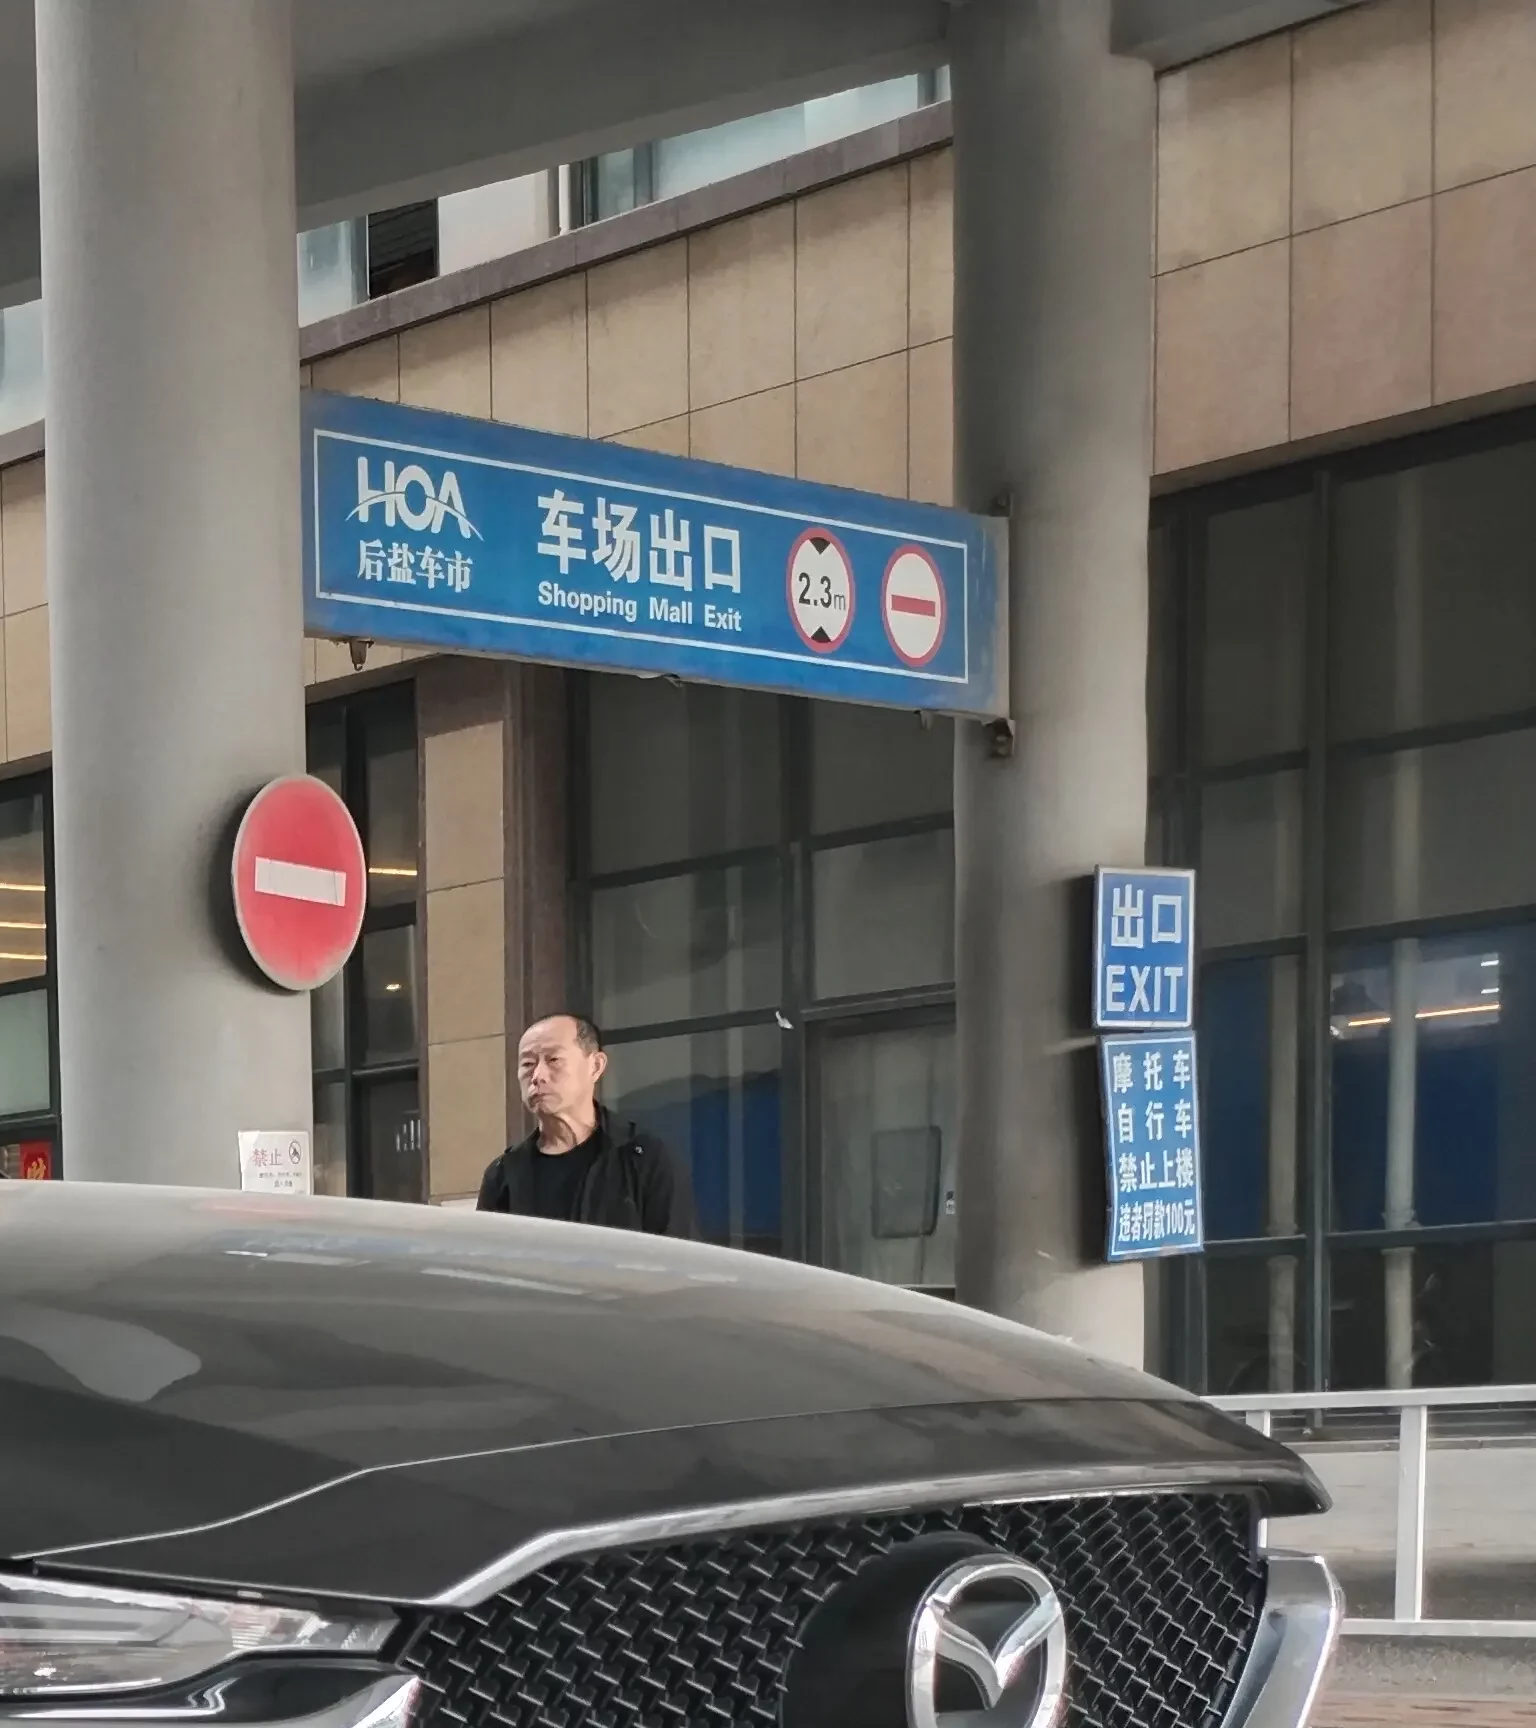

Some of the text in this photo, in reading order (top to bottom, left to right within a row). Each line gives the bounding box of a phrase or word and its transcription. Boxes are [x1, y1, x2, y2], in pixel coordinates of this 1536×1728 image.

[356, 456, 473, 539] HOA
[357, 538, 474, 593] 后盐车市
[537, 488, 741, 594] 车场出口
[537, 580, 742, 632] Shopping Mall Exit
[798, 572, 846, 611] 2.3m
[1110, 883, 1183, 949] 出口
[1105, 964, 1184, 1013] EXIT
[1112, 1048, 1191, 1094] 摩托车
[1117, 1099, 1193, 1144] 自行车
[252, 1148, 283, 1168] 禁止
[1118, 1149, 1195, 1193] 禁止上楼
